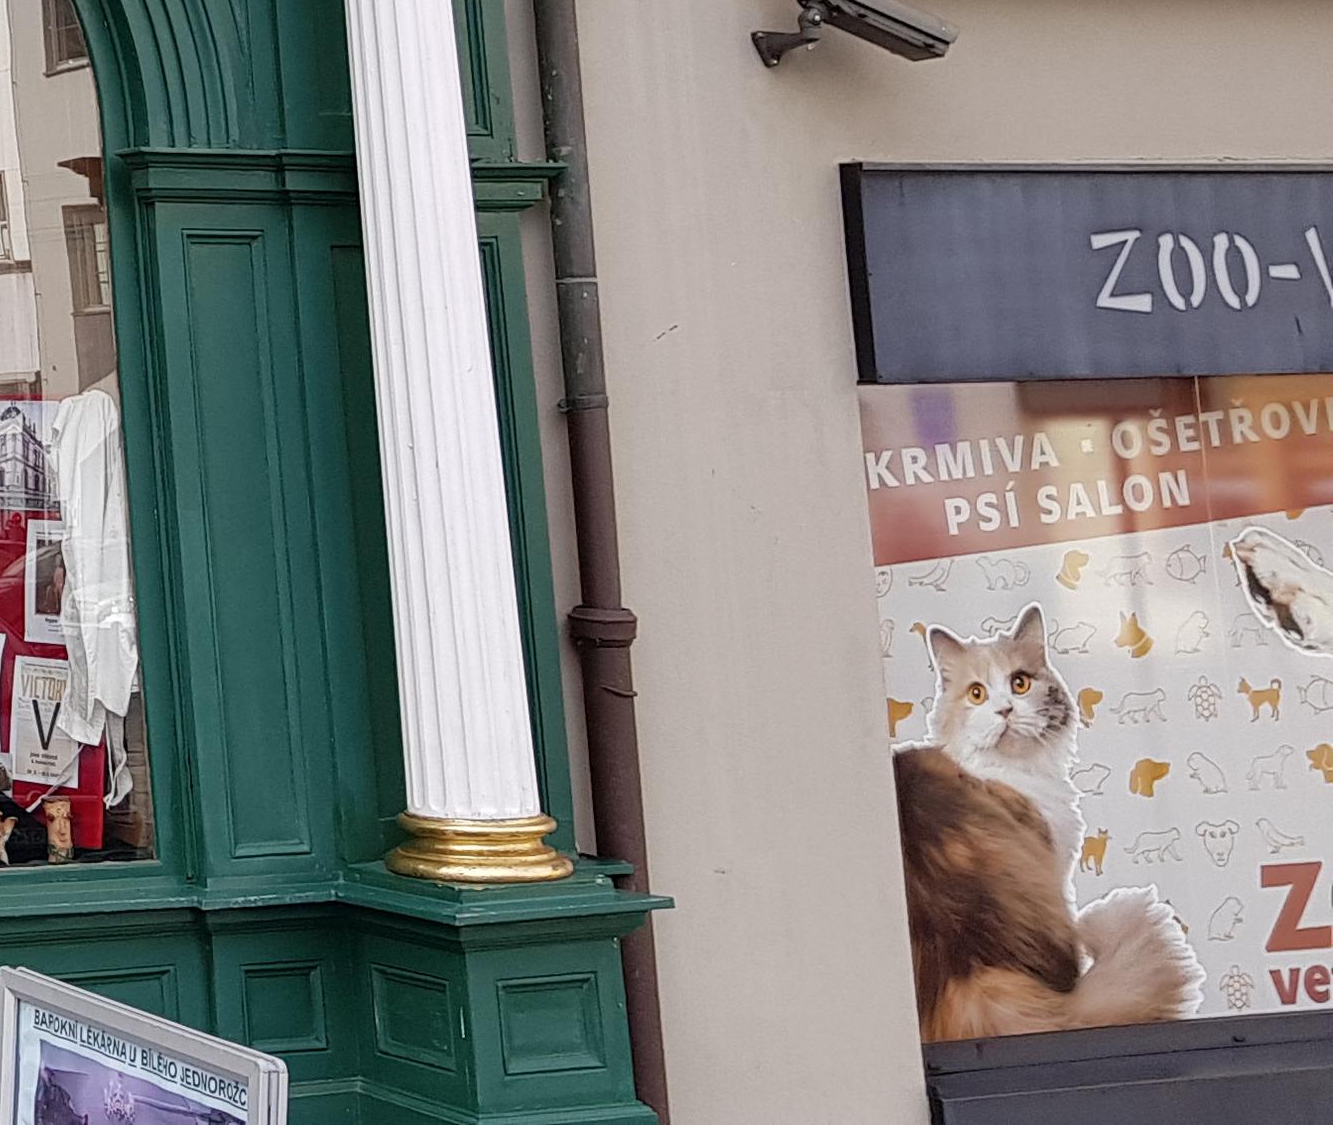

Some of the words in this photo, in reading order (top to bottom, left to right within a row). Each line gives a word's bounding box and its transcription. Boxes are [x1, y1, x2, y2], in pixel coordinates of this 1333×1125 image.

[1090, 226, 1333, 313] ZOO-
[866, 432, 1061, 490] KRMIVA
[944, 481, 1021, 535] PSÍ
[1036, 469, 1191, 525] SALON
[1268, 963, 1333, 1005] ve
[179, 1065, 248, 1107] JEDNOROŽC
